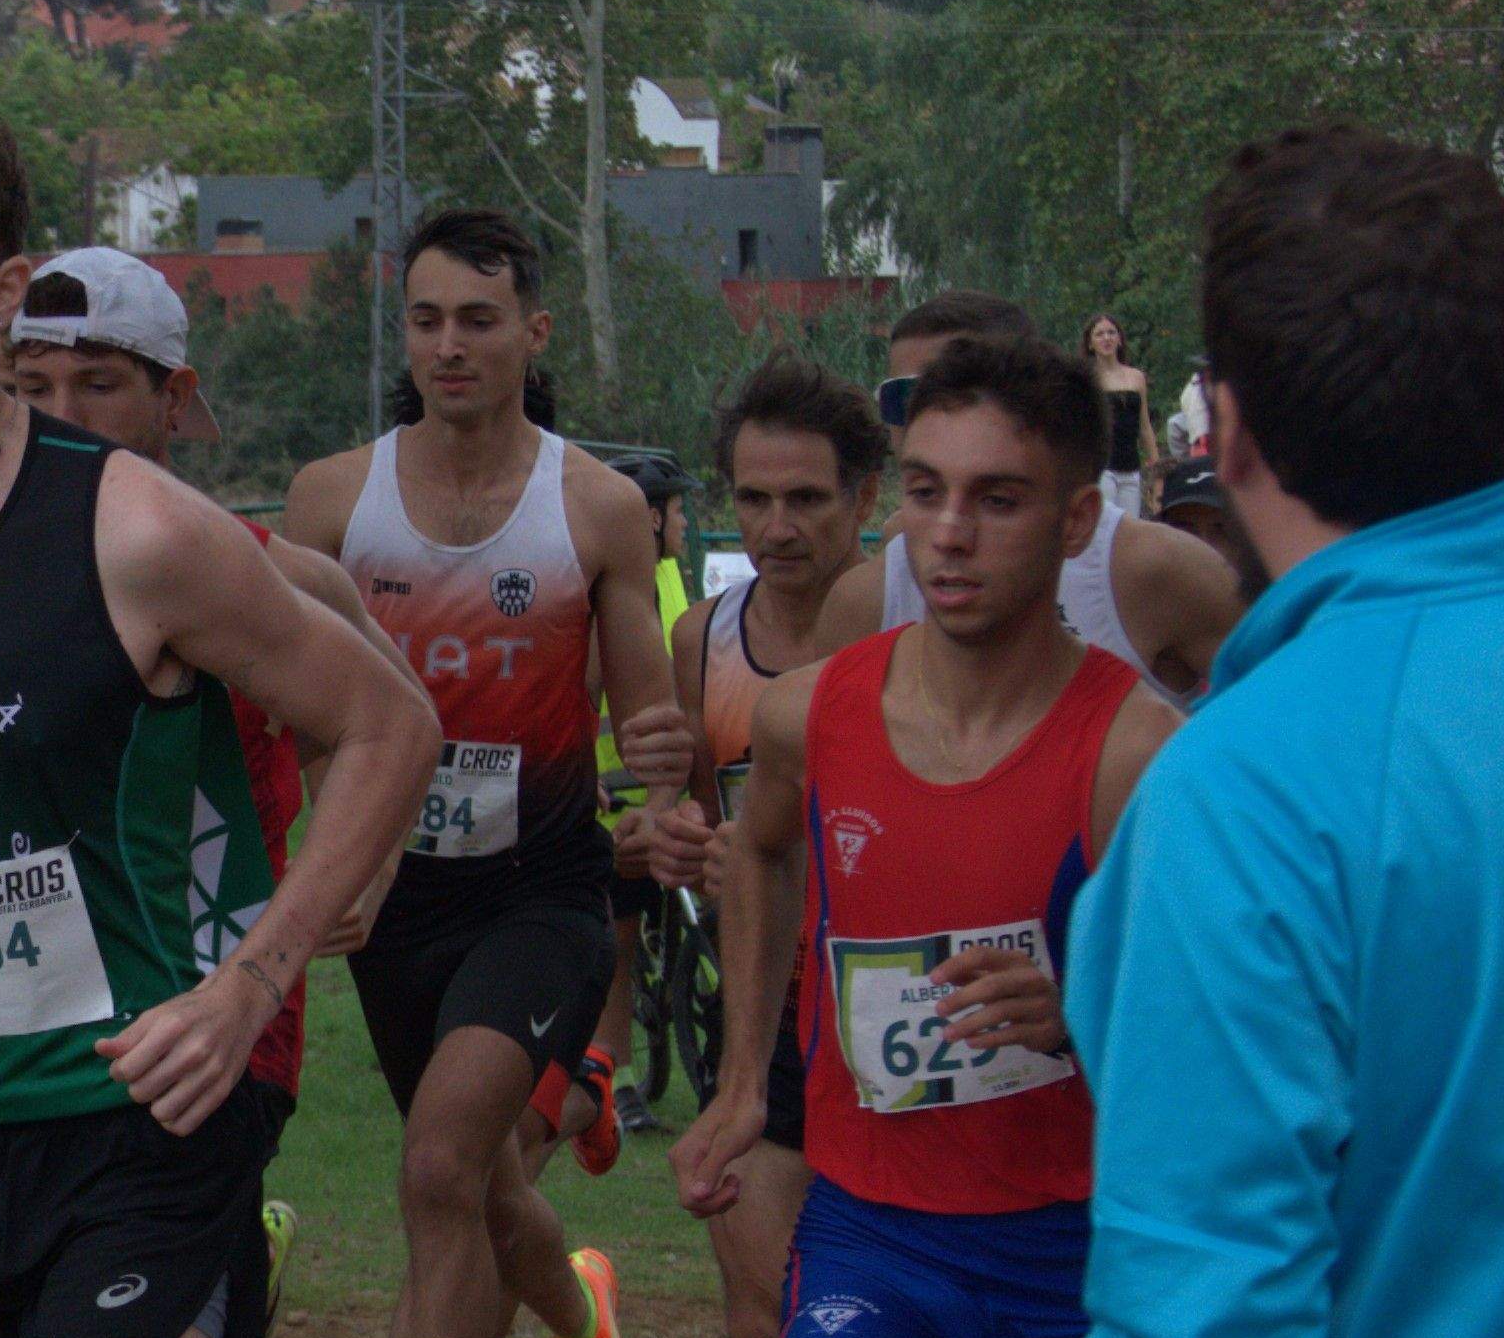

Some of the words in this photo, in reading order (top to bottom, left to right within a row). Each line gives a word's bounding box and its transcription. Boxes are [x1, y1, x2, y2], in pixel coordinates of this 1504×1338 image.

[459, 747, 514, 771] CROS
[423, 794, 475, 835] 84
[901, 984, 955, 1003] ALBER
